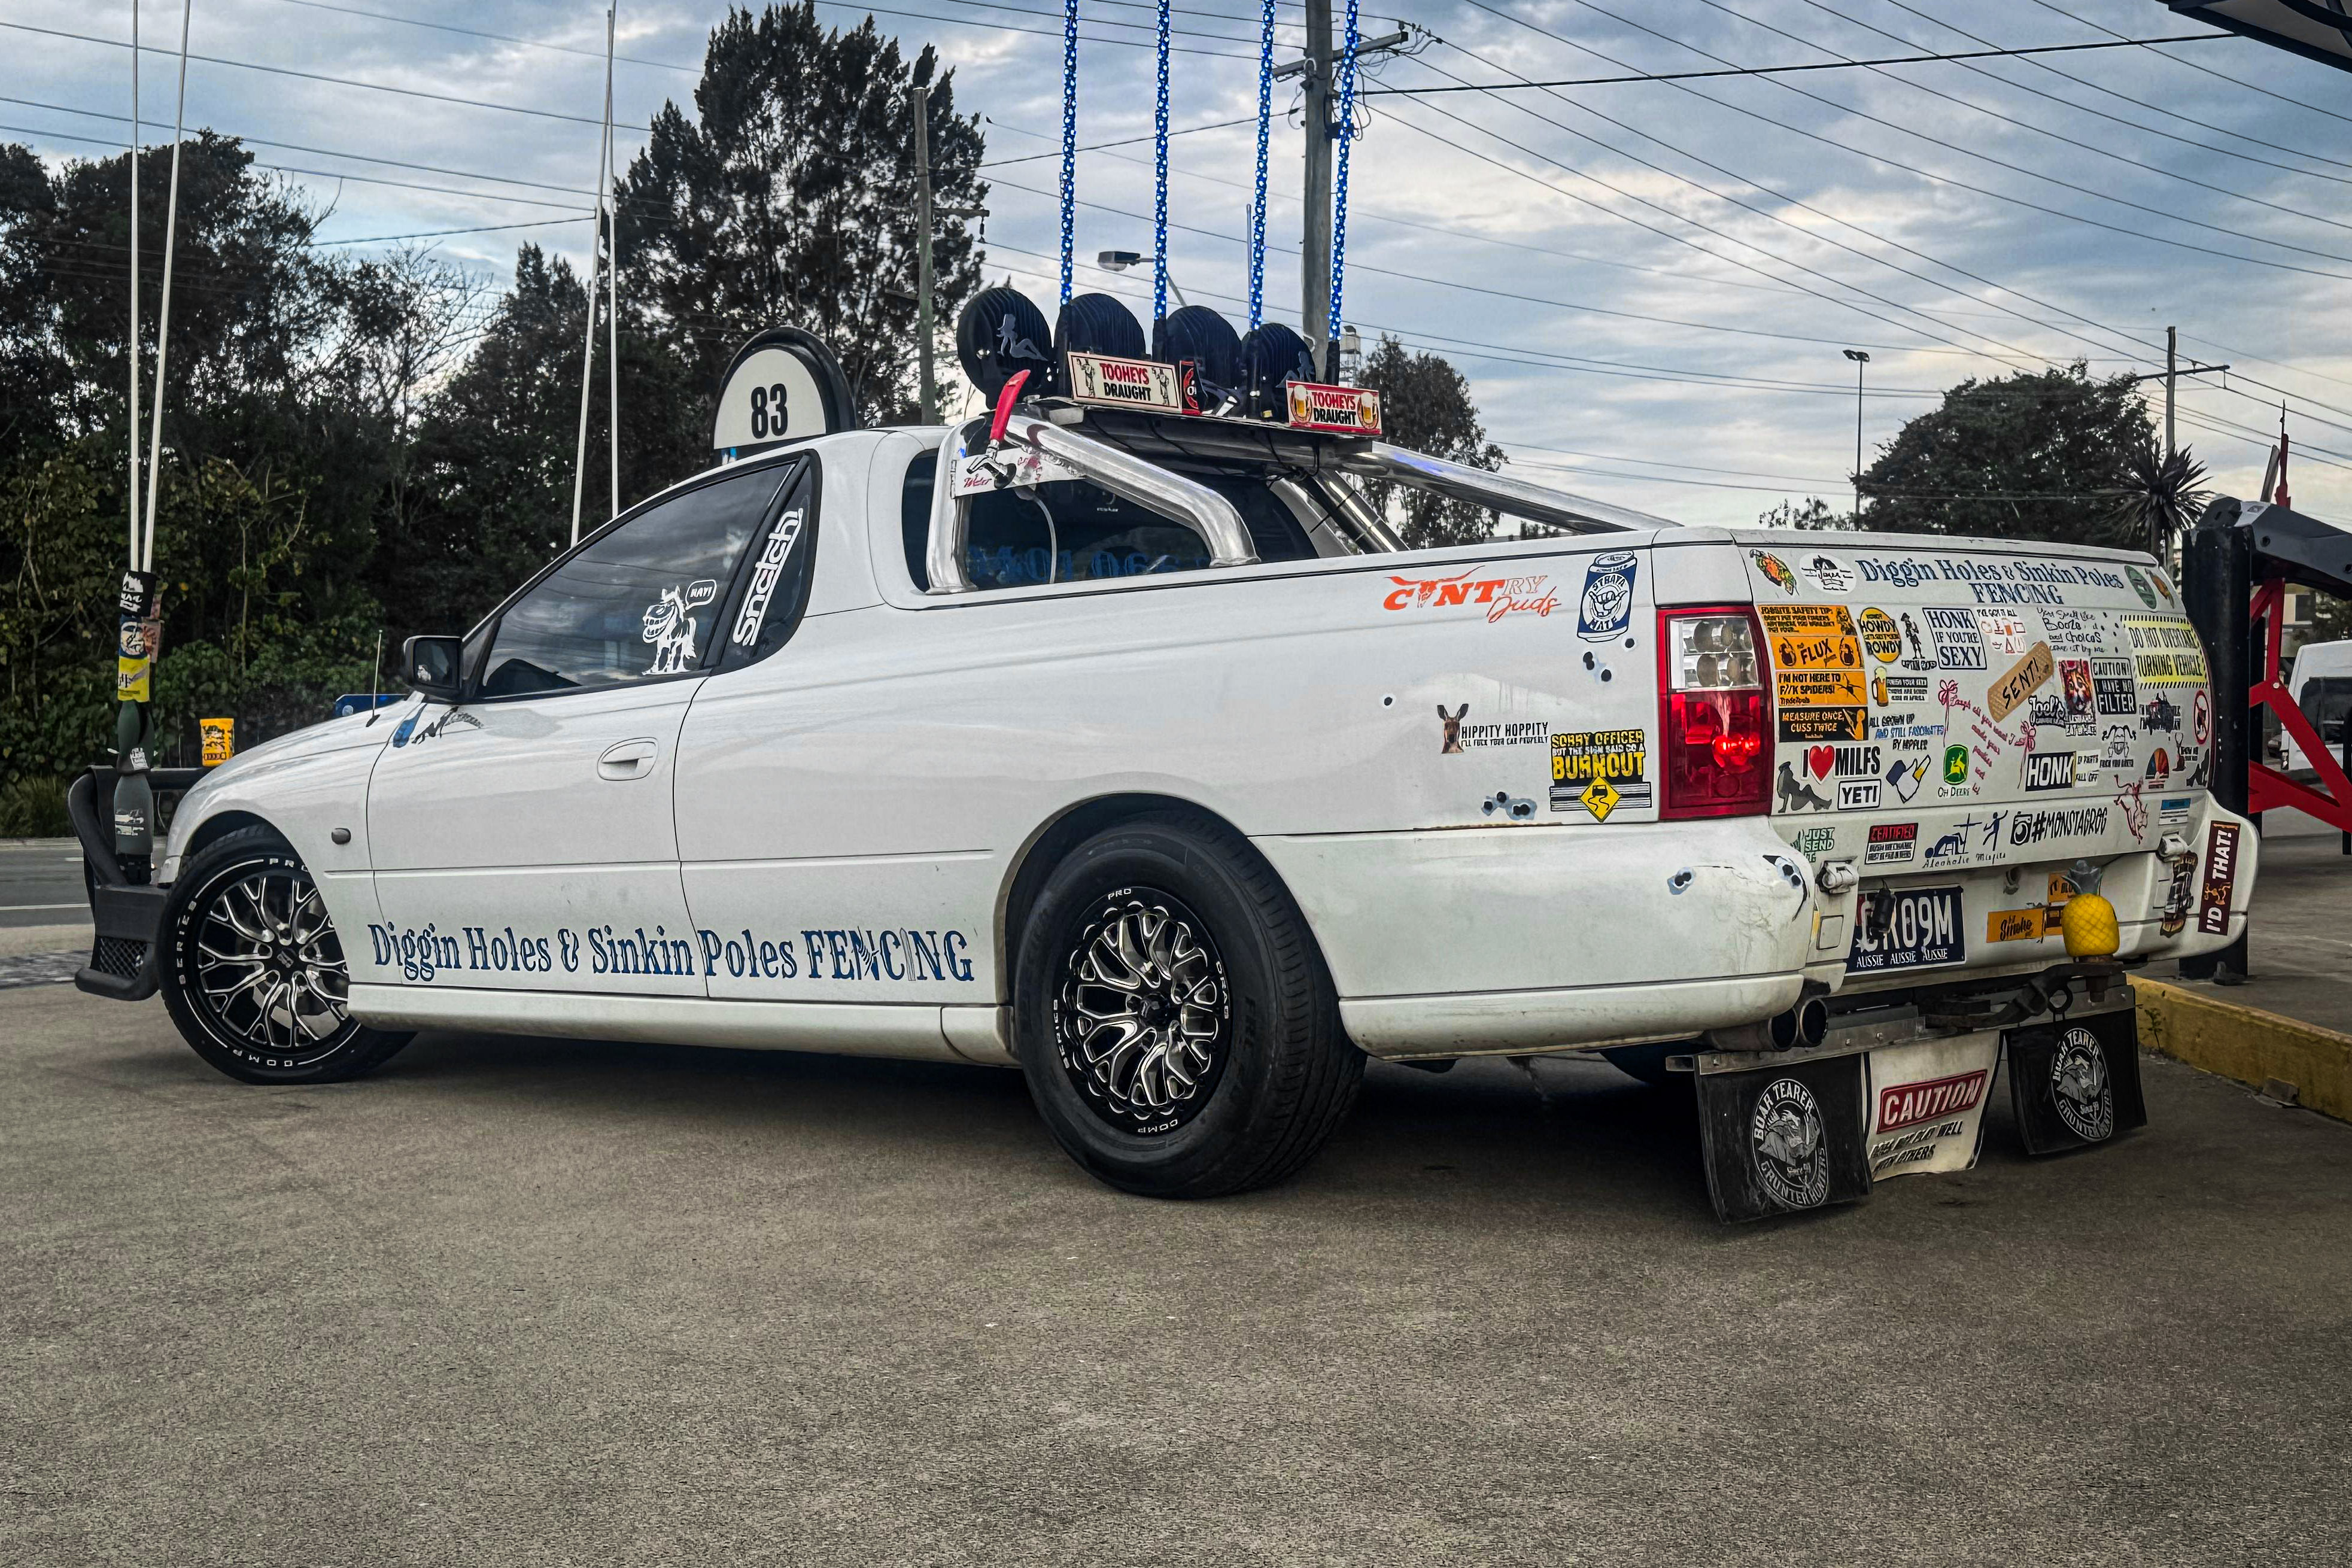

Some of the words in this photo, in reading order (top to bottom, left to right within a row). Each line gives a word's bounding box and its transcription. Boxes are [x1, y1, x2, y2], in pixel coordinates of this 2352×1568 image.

[1099, 363, 1150, 385] TOOHEYS
[1104, 382, 1151, 401] DRAUGHT
[1311, 391, 1356, 410] TOOHEYS
[750, 383, 788, 439] 83
[1313, 408, 1357, 426] DRAUGHT
[1855, 558, 1938, 587] Diggin
[1934, 560, 2002, 581] Holes
[2013, 561, 2079, 585] Sinkin
[2073, 566, 2124, 589] Poles
[1969, 582, 2064, 604] FENCING
[1926, 610, 1975, 629] HONK
[1935, 632, 1944, 643] IF
[2129, 627, 2144, 648] DO
[2143, 627, 2161, 648] NOT
[1800, 638, 1832, 664] FLUX
[1940, 645, 1981, 666] SEXY
[2135, 654, 2173, 677] TURNING
[2172, 654, 2203, 676] VEHICLE
[1779, 673, 1790, 683] I'M
[1792, 673, 1808, 683] NOT
[1809, 673, 1830, 682] HERE
[1831, 673, 1841, 682] TO
[2002, 657, 2042, 709] SENT!
[2098, 694, 2135, 713] FILTER
[1782, 712, 1821, 721] MEASURE
[1461, 724, 1502, 739] HIPPITY
[1505, 721, 1549, 737] HOPPITY
[1791, 724, 1812, 732] CUSS
[1814, 723, 1837, 732] TWICE
[1552, 733, 1591, 748] SORRY
[1595, 730, 1643, 746] OFFICER
[1892, 739, 1902, 750] BY
[1569, 747, 1584, 756] THE
[1585, 746, 1604, 755] SIGN
[1605, 744, 1624, 753] SAID
[1639, 743, 1645, 752] A
[1552, 752, 1645, 780] BURNOUT
[1803, 749, 1808, 777] I
[1835, 746, 1880, 776] MILFS
[2026, 755, 2074, 787] HONK
[1842, 785, 1878, 804] YETI
[1805, 827, 1836, 839] JUST
[1804, 838, 1835, 852] SEND
[2212, 829, 2232, 880] THAT!
[1108, 888, 1132, 900] PRO
[2206, 907, 2223, 932] I'D
[367, 921, 463, 981] Diggin
[462, 926, 552, 973] Holes
[558, 928, 579, 973] &
[588, 924, 695, 976] Sinkin
[697, 928, 797, 979] Poles
[801, 926, 975, 981] FENCING
[1856, 954, 1884, 968] AUSSIE
[1890, 951, 1916, 965] AUSSIE
[1922, 948, 1948, 962] AUSSIE
[1884, 1077, 1982, 1126] CAUTION
[1754, 1095, 1774, 1142] BOAR
[1773, 1082, 1815, 1114] TEARER
[1138, 1119, 1178, 1134] COMP
[1937, 1120, 1963, 1138] WELL
[1895, 1144, 1936, 1164] OTHERS
